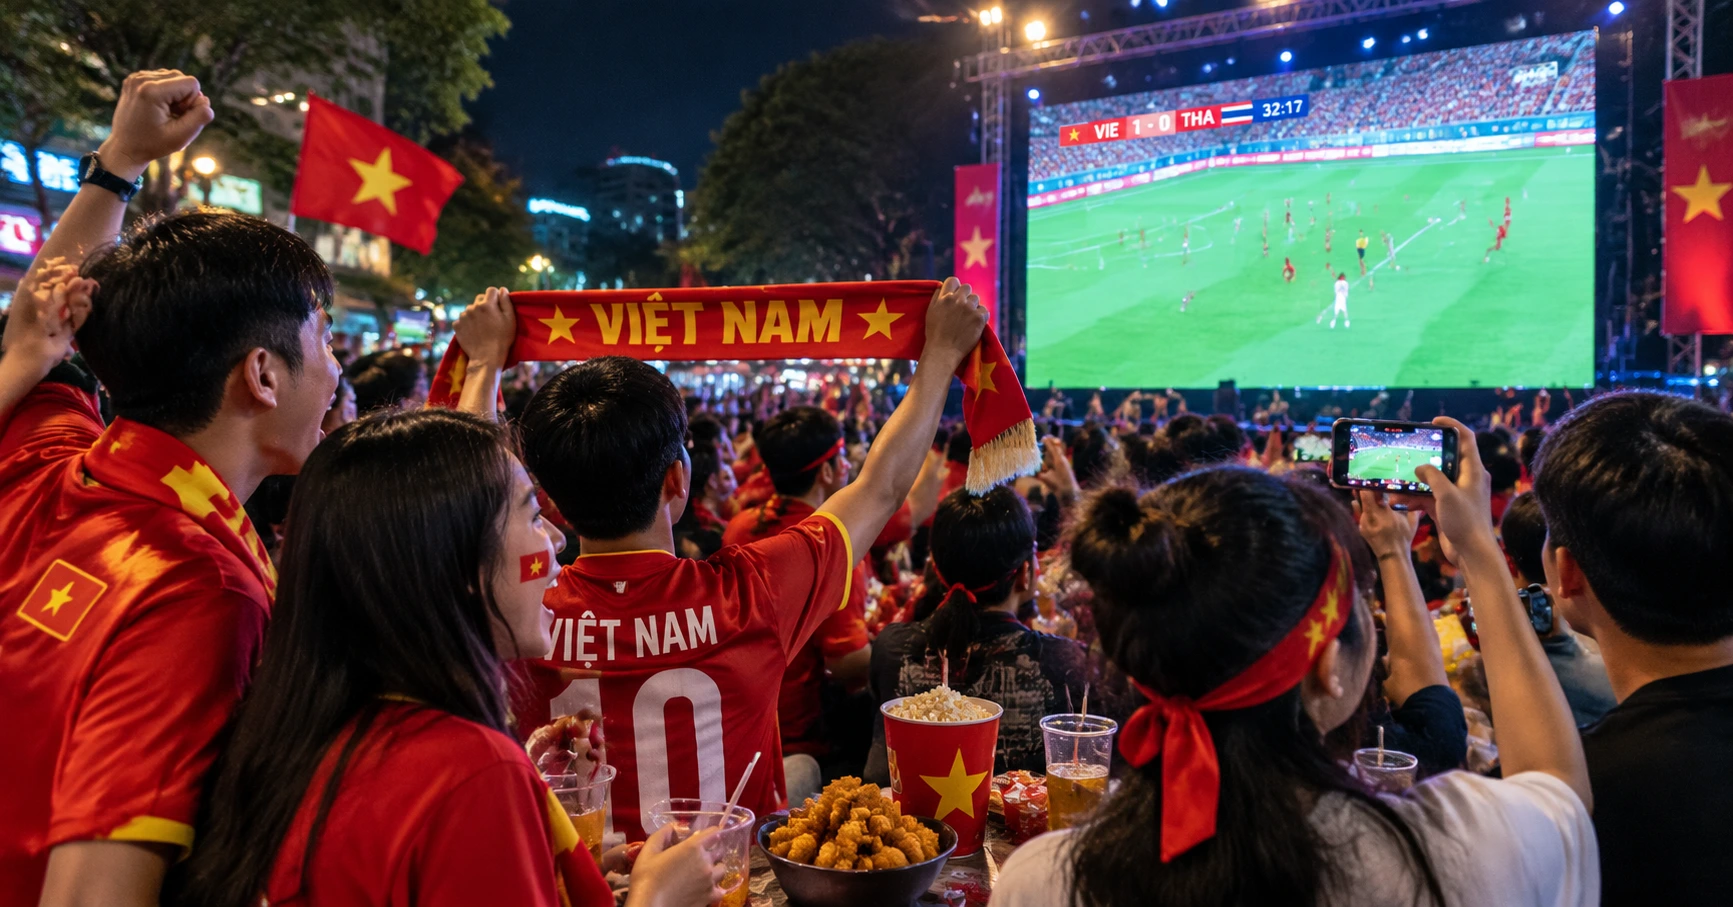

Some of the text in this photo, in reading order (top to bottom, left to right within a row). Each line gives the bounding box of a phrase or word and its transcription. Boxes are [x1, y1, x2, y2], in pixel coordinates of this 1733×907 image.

[1094, 122, 1119, 140] VIE
[1131, 119, 1141, 136] 1
[1158, 114, 1171, 132] 0
[1180, 109, 1215, 127] THA
[1262, 99, 1304, 118] 32:17
[589, 291, 843, 353] VIỆT NAM
[633, 604, 718, 658] NAM
[549, 667, 727, 841] 10
